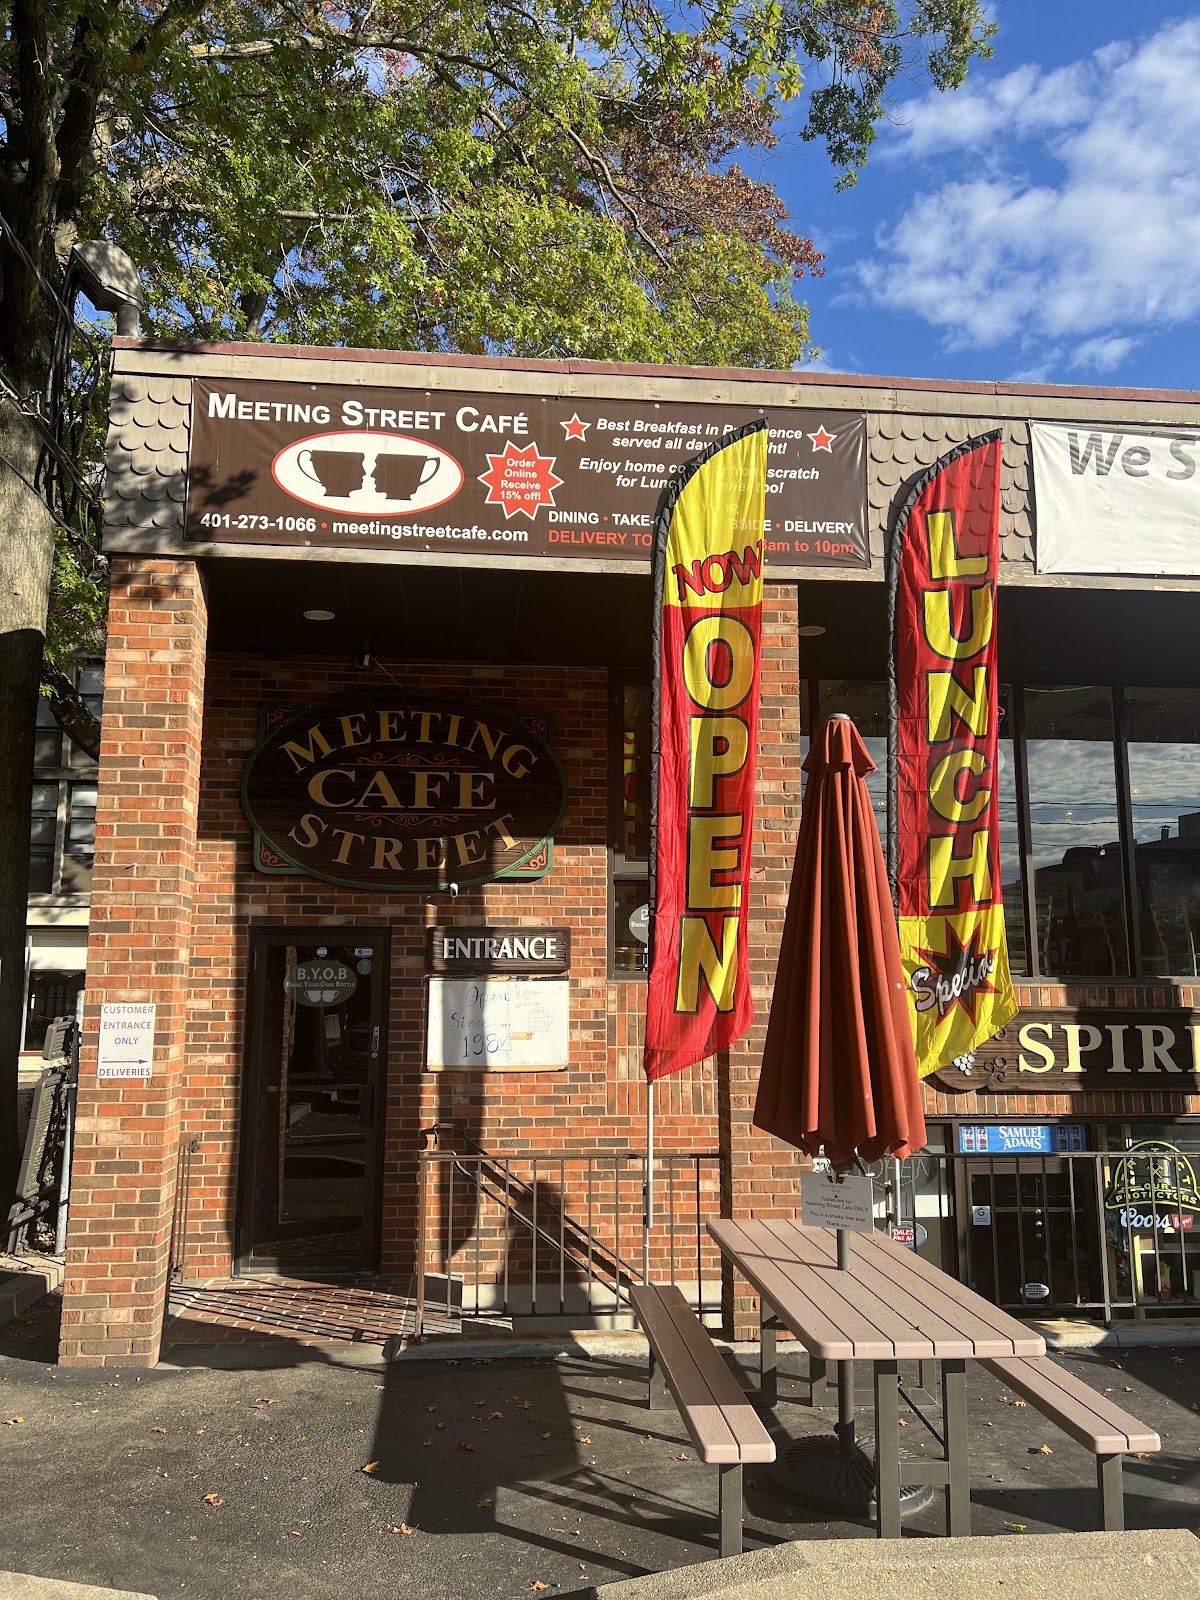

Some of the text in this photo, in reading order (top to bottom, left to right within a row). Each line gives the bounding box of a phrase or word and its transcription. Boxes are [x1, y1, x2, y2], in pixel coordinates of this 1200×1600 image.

[208, 392, 529, 435] MEETING STREET CAFÉ
[597, 418, 802, 440] Best Breakfast in Pence
[612, 437, 662, 449] served
[665, 438, 682, 450] all
[506, 458, 536, 468] Order
[1067, 432, 1152, 478] We
[504, 469, 538, 478] Online
[579, 458, 622, 474] Enjoy
[624, 460, 666, 473] home
[767, 468, 820, 480] scratch
[500, 480, 541, 490] Receive
[616, 475, 638, 487] for
[500, 490, 522, 500] 15%
[200, 512, 528, 542] 401-273-1066 meetingstreetcafe.com
[548, 511, 599, 524] DINING
[784, 520, 854, 534] DELIVERY
[548, 530, 628, 545] DELIVERY
[632, 533, 652, 546] TO
[794, 540, 810, 552] to
[814, 540, 854, 556] 10pm
[672, 539, 763, 602] NOW
[922, 507, 994, 911] LUNCH
[279, 710, 538, 779] MEETING
[308, 769, 497, 810] CAFE
[673, 613, 756, 1014] OPEN
[287, 812, 520, 871] STREET
[443, 938, 557, 960] ENTRANCE
[466, 986, 510, 1008] Open
[104, 1006, 154, 1014] CUSTOMER
[104, 1022, 152, 1030] ENTRANCE
[462, 1032, 513, 1058] 1984
[100, 1068, 150, 1076] DELIVERIES
[998, 1126, 1046, 1138] SAMUEL
[1004, 1138, 1042, 1150] ADAMS
[1144, 1182, 1168, 1190] OUR
[1116, 1191, 1198, 1204] POTCTORS
[1120, 1208, 1171, 1228] Coors
